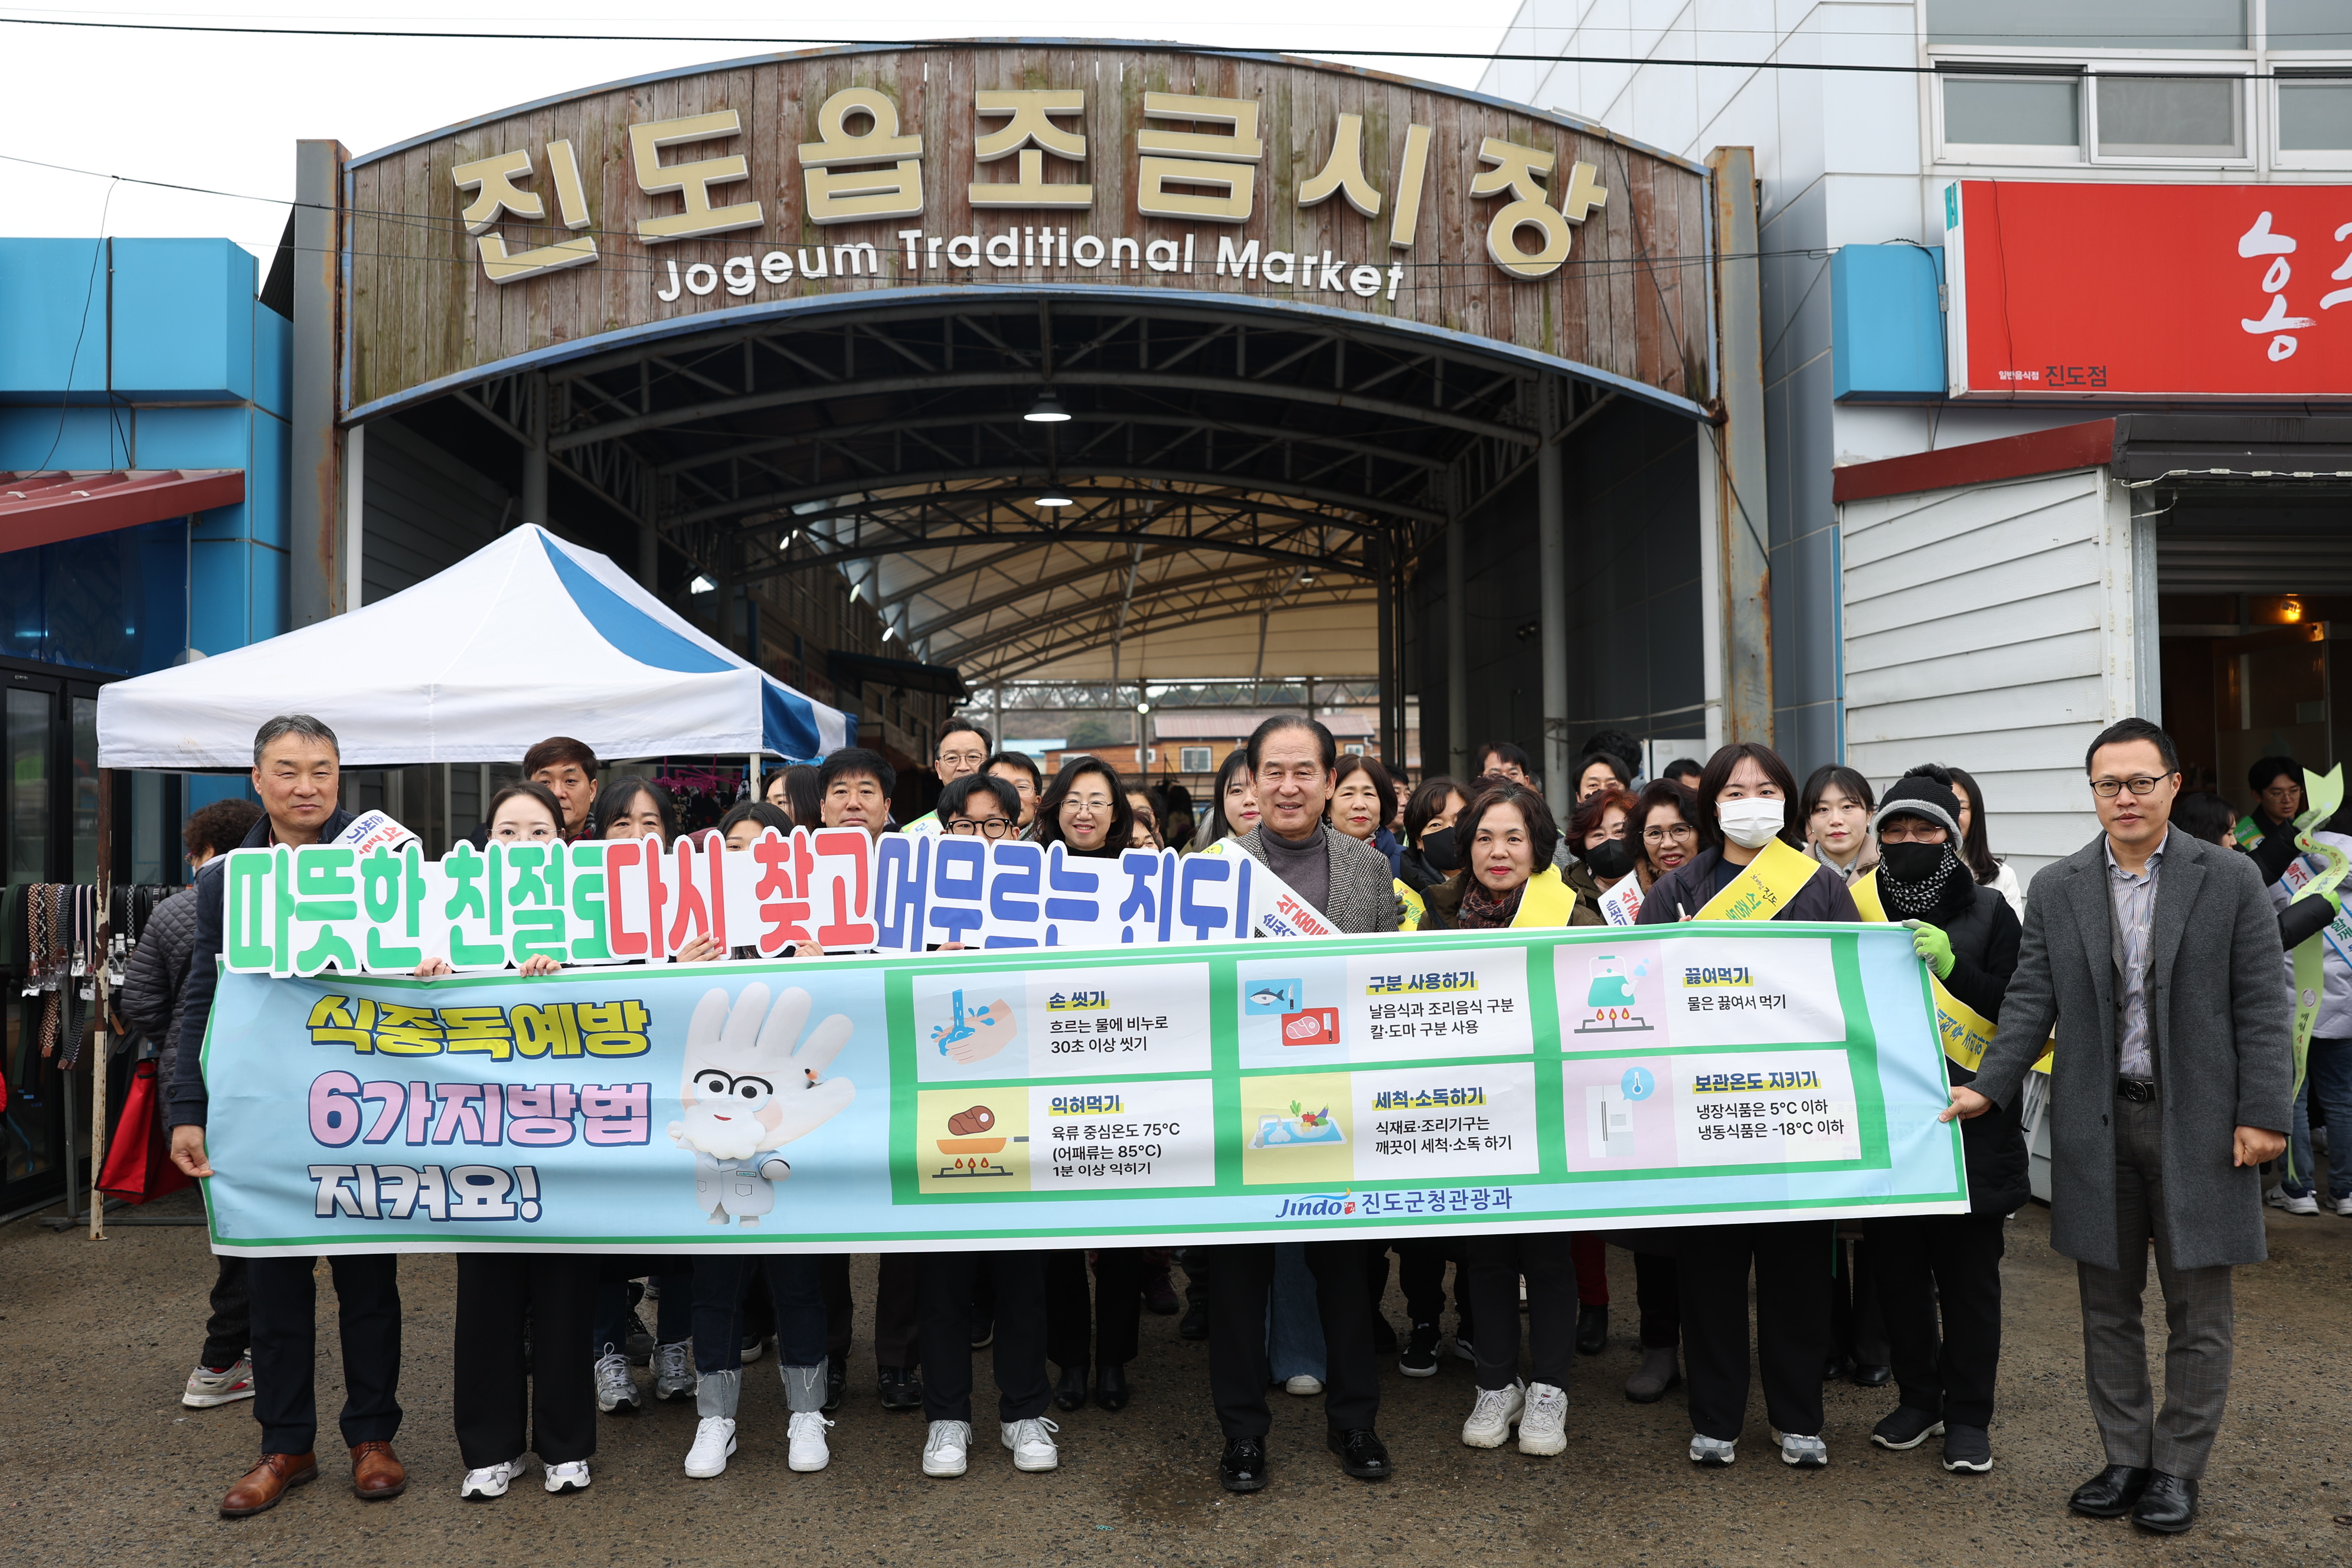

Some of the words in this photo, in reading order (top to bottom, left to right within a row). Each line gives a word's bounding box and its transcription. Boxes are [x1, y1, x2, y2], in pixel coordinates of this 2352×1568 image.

[451, 86, 1608, 285] 진도읍조금시장
[658, 236, 878, 302] Jogeum
[898, 226, 1194, 273] Traditional
[1216, 229, 1404, 300] Market
[1998, 370, 2040, 381] 일반음식점
[2045, 365, 2107, 387] 진도점
[229, 847, 426, 972] 따뜻한
[607, 835, 727, 958] 다시
[754, 831, 874, 947] 찾고
[874, 828, 1099, 951] 머무르는
[1763, 887, 1778, 907] 진도
[1369, 975, 1402, 993] 구분
[1407, 972, 1475, 991] 사용하기
[1685, 967, 1749, 984] 끓여먹기
[1050, 992, 1066, 1009] 손
[1071, 991, 1105, 1008] 씻기
[1370, 1002, 1424, 1019] 날음식과
[1428, 999, 1482, 1016] 조리음식
[1487, 998, 1514, 1013] 구분
[1688, 997, 1714, 1011] 물은
[1717, 995, 1756, 1010] 끓여서
[1759, 994, 1786, 1009] 먹기
[307, 994, 652, 1061] 식중독예방
[1050, 1020, 1092, 1034] 흐르는
[1095, 1018, 1122, 1033] 물에
[1127, 1017, 1168, 1031] 비누로
[1371, 1023, 1416, 1039] 칼·도마
[1420, 1022, 1448, 1037] 구분
[1451, 1020, 1479, 1035] 사용
[1051, 1040, 1085, 1053] 30초
[1089, 1038, 1116, 1053] 이상
[1120, 1036, 1146, 1051] 씻기
[1696, 1073, 1763, 1092] 보관온도
[1769, 1071, 1818, 1089] 지키기
[1051, 1095, 1120, 1114] 익혀먹기
[1697, 1102, 1766, 1119] 냉장식품은
[1770, 1102, 1798, 1115] 5°C
[1801, 1099, 1828, 1115] 이하
[1051, 1126, 1080, 1141] 육류
[1083, 1125, 1139, 1139] 중심온도
[1143, 1123, 1180, 1136] 75°C
[1698, 1123, 1768, 1140] 냉동식품은
[1817, 1119, 1844, 1135] 이하
[1053, 1146, 1114, 1162] (어패류는
[1118, 1144, 1162, 1158] 85°C)
[1376, 1139, 1416, 1155] 깨끗이
[1420, 1136, 1481, 1154] 세척·소독
[1484, 1135, 1511, 1151] 하기
[1053, 1165, 1074, 1177] 1분
[1078, 1164, 1106, 1176] 이상
[1109, 1162, 1151, 1175] 익히기
[308, 1164, 542, 1222] 지켜요!
[1362, 1187, 1513, 1215] 진도군청관광과
[1276, 1196, 1342, 1218] Jindo
